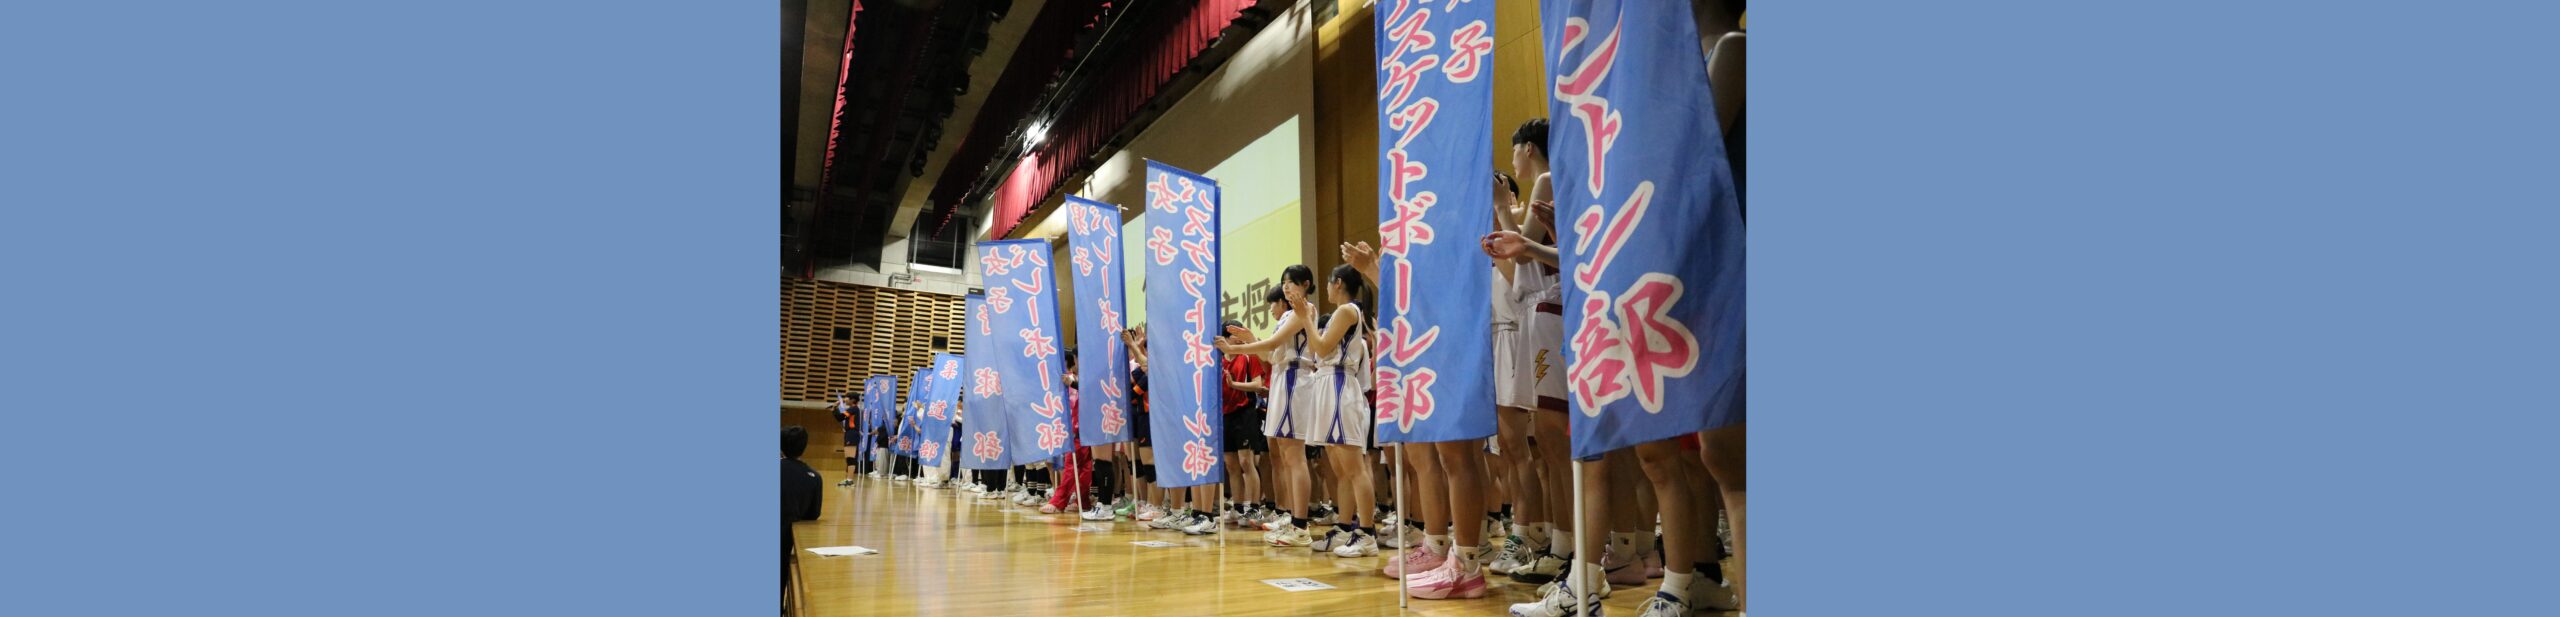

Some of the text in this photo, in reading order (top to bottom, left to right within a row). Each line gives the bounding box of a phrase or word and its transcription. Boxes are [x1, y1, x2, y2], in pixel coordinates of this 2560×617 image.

[1442, 0, 1494, 83] 子
[1376, 0, 1439, 434] スケットボール部
[919, 359, 959, 462] 柔道部
